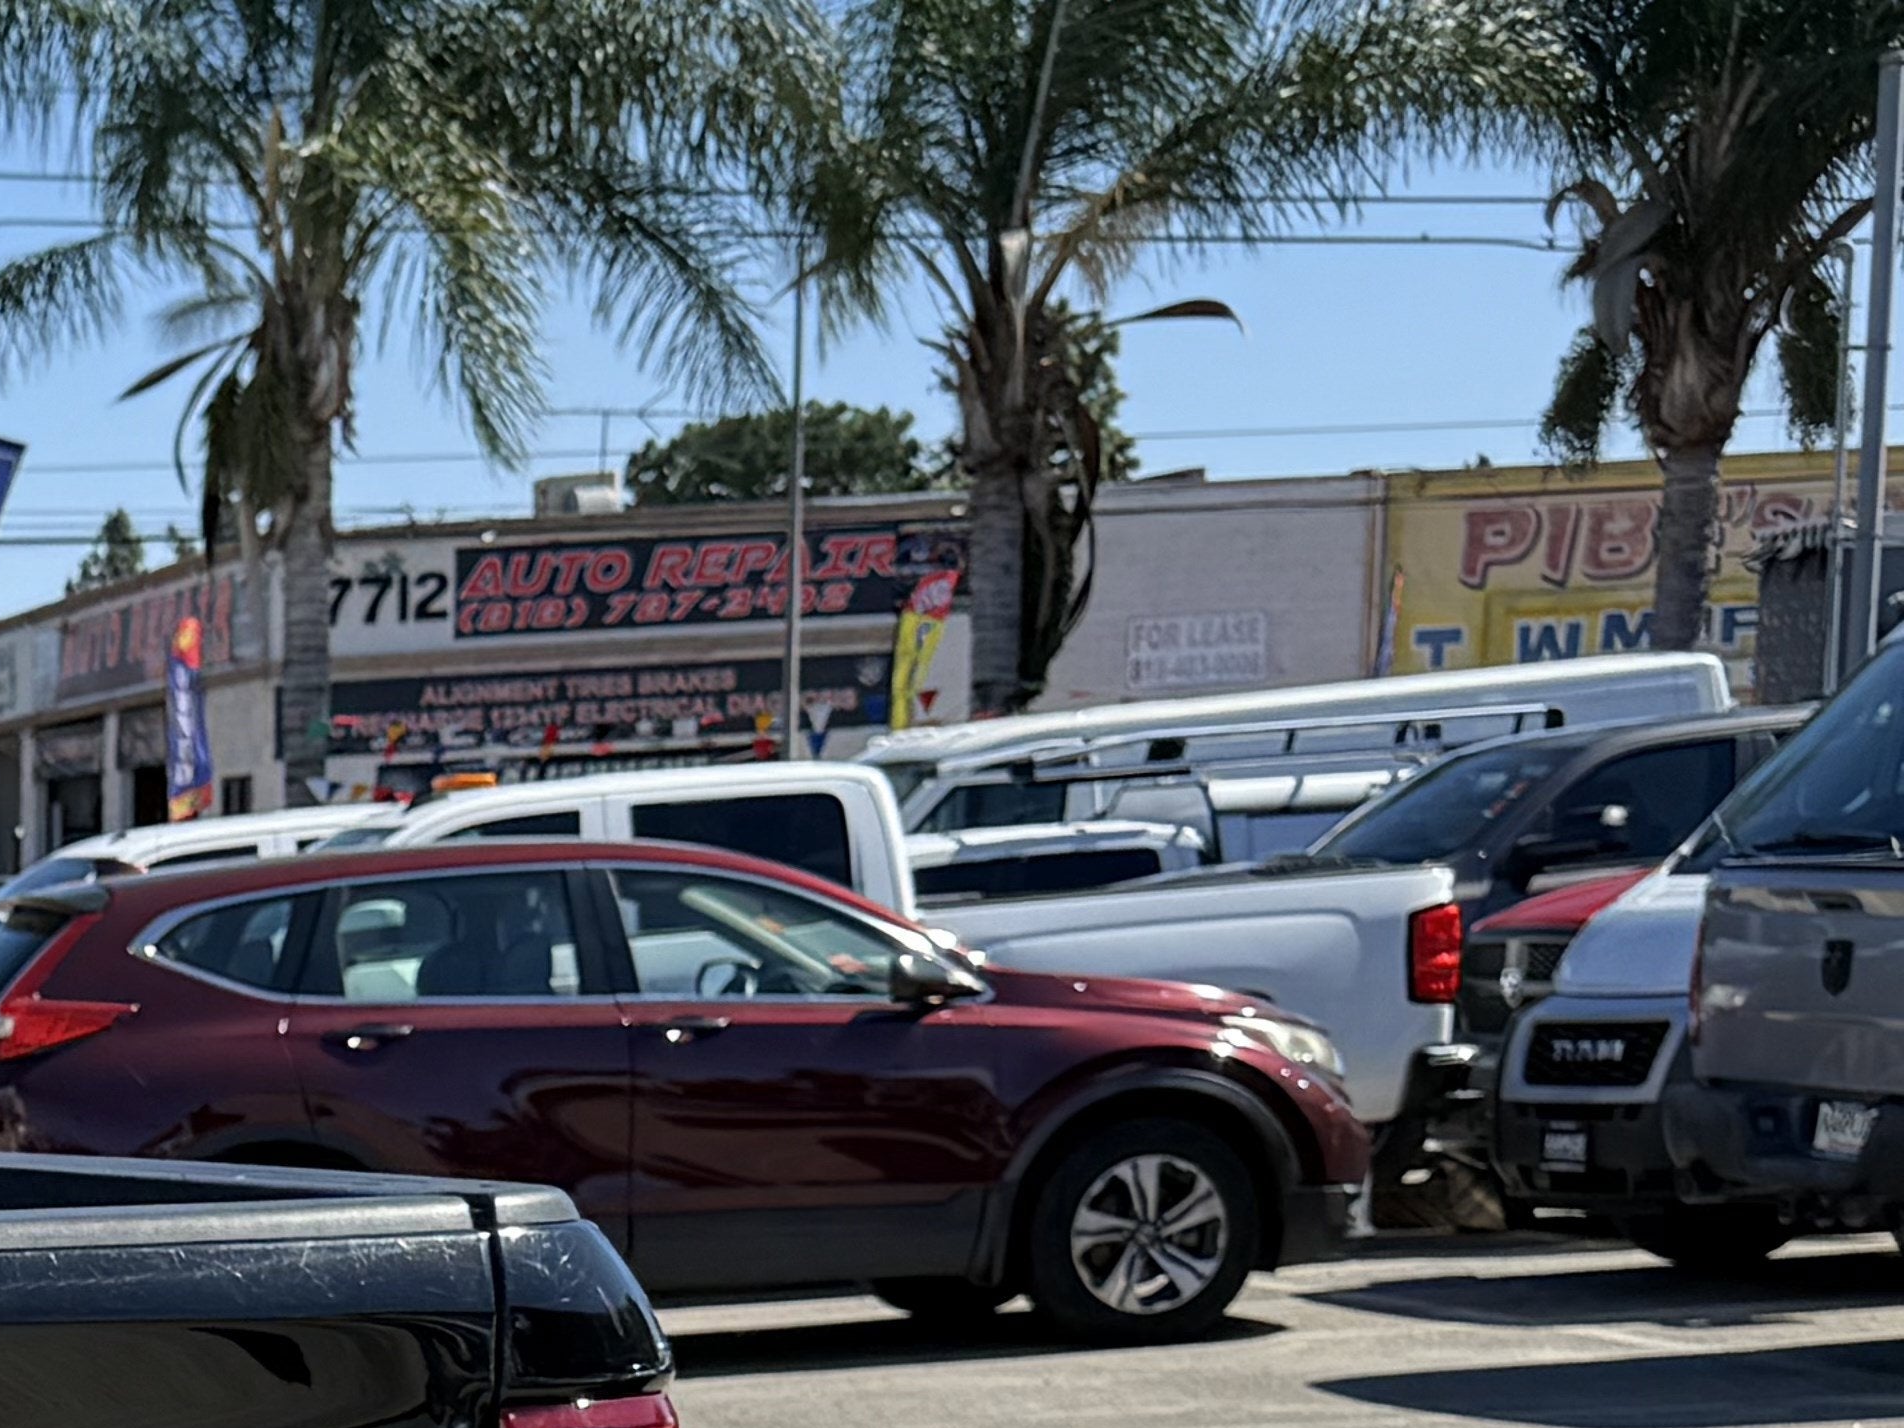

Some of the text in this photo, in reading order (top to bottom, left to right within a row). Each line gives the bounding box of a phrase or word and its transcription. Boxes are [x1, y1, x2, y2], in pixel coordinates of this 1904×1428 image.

[328, 571, 449, 626] 7712
[459, 534, 898, 602] AUTO REPAIR
